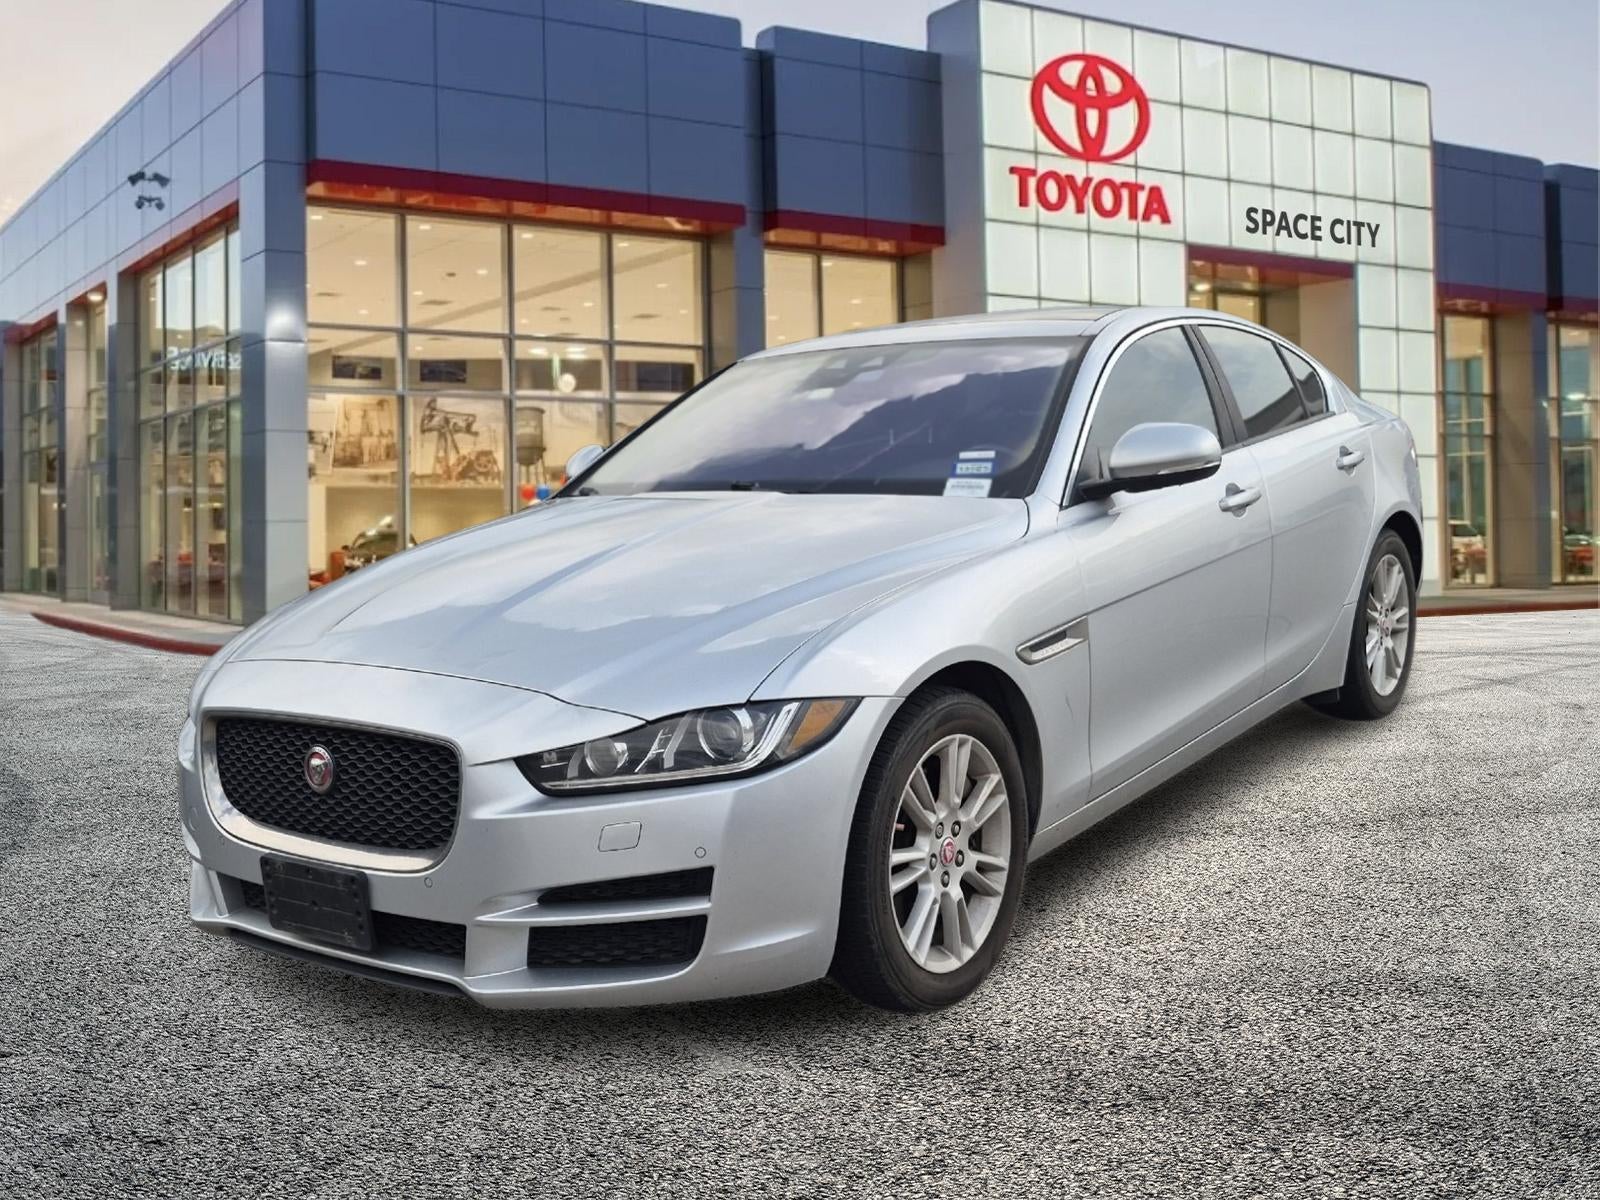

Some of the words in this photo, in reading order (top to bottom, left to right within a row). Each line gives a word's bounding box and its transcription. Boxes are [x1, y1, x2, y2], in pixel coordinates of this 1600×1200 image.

[1009, 166, 1171, 224] TOYOTA
[1245, 206, 1322, 241] SPACE
[1329, 218, 1380, 247] CITY
